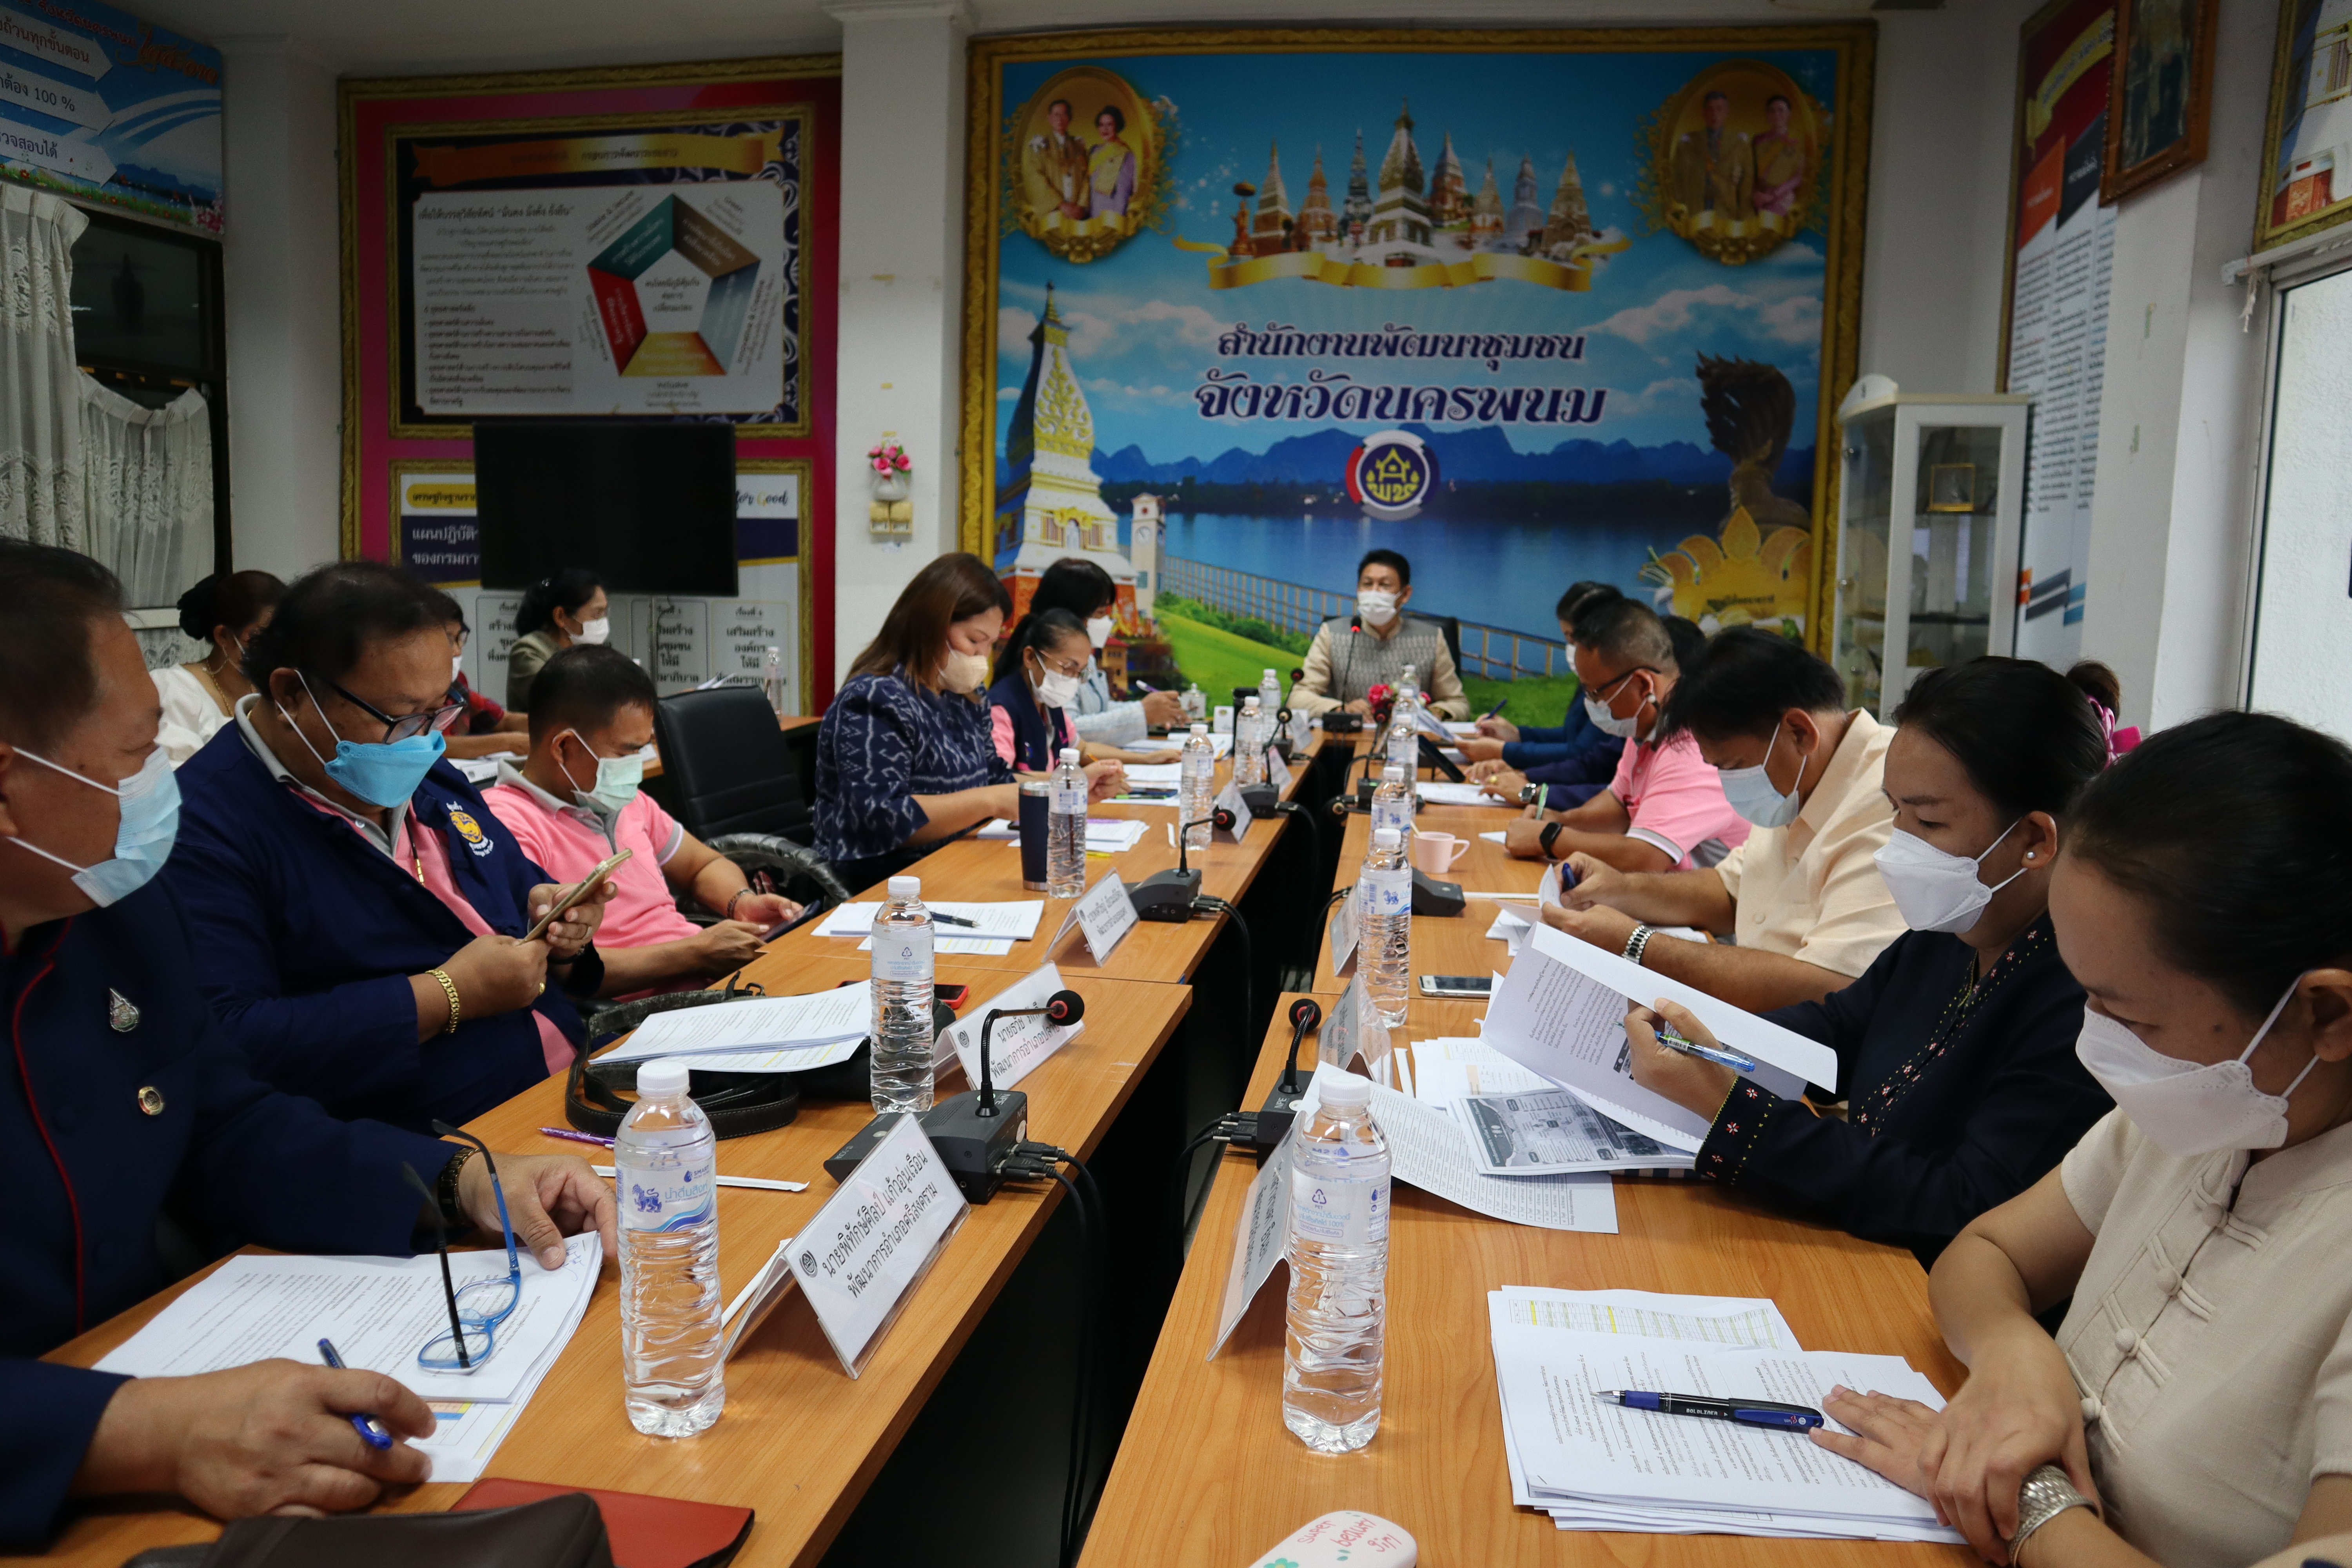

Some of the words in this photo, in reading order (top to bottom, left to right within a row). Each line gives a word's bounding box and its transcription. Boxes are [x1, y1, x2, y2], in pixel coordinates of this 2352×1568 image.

[34, 87, 57, 106] 100
[62, 96, 75, 112] %
[1218, 322, 1586, 372] สำนักงานพัฒนาชุมชน
[1194, 368, 1607, 424] จังหวัดนครพนม
[412, 524, 479, 544] แผนปฏิบัติ
[995, 1093, 1011, 1105] NPE
[1274, 1097, 1287, 1109] NPE
[693, 1165, 710, 1176] SMART
[665, 1180, 707, 1199] น้ำดื่มสิงห์
[822, 1191, 886, 1278] นายพิทักษ์ศิลป์
[885, 1149, 928, 1207] แก้วอุ่นเรือน
[847, 1181, 938, 1298] พัฒนาการอำเภอศรีสงคราม
[1297, 1520, 1336, 1544] Super
[1367, 1534, 1403, 1553] girl
